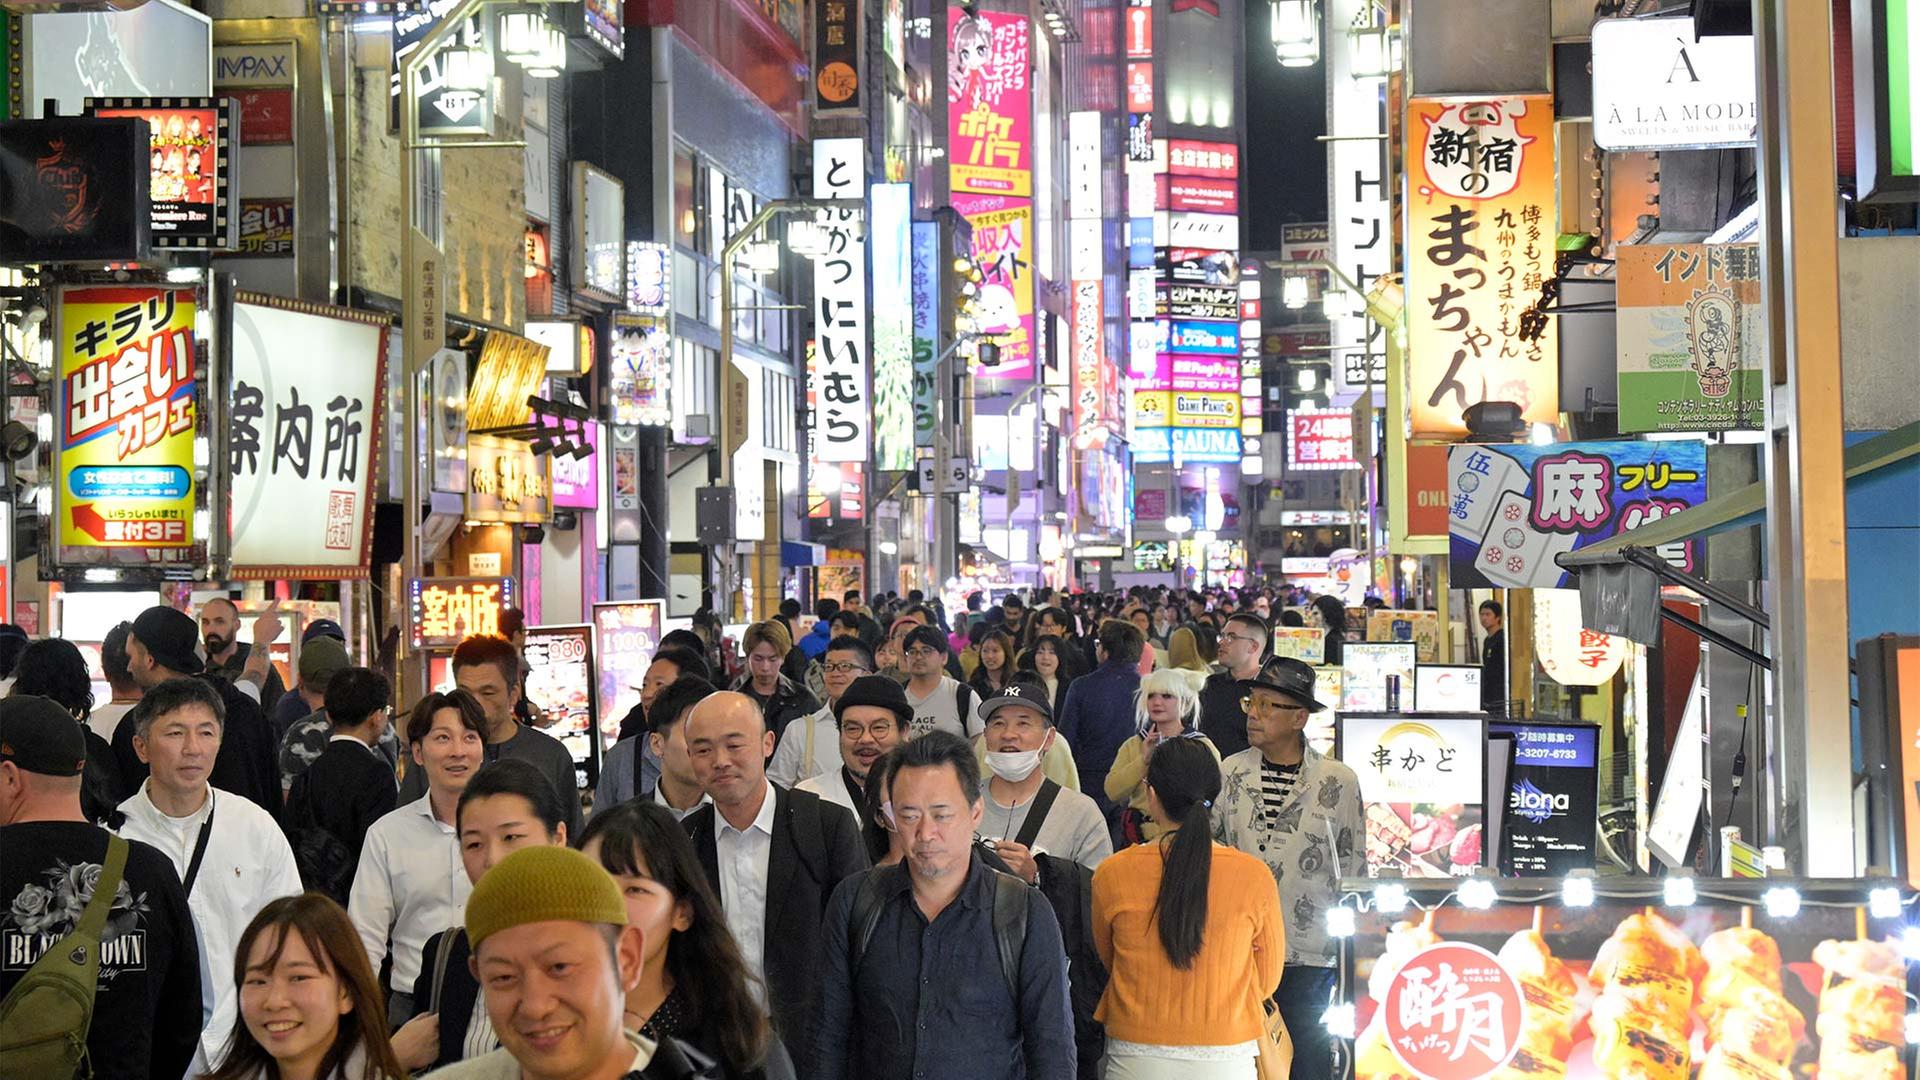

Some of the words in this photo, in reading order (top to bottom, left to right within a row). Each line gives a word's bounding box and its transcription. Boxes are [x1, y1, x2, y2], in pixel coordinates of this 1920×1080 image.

[217, 55, 286, 78] IMPAX
[991, 27, 1004, 105] ガールズバー
[1003, 24, 1015, 88] コンカフェ
[1015, 19, 1026, 90] キャバクラ
[1666, 37, 1700, 83] À
[958, 102, 1014, 137] ポケ
[1609, 103, 1622, 123] À
[1637, 106, 1667, 123] LA
[969, 136, 1021, 167] パラ
[1429, 126, 1518, 173] 新宿
[1461, 172, 1490, 195] の
[189, 210, 207, 222] Rue
[976, 209, 1028, 231] 今すぐ見つかる
[822, 157, 862, 443] とんかつにいむら
[1495, 207, 1519, 358] 九州のうまかもん
[74, 291, 175, 357] キラリ
[1427, 204, 1492, 416] まっちゃん
[69, 330, 190, 437] 出会い
[118, 393, 193, 461] カフェ
[232, 381, 363, 482] 案内所
[1172, 429, 1240, 453] SAUNA
[926, 467, 966, 482] ちら
[1617, 465, 1697, 491] フリー
[421, 584, 500, 637] 案内所
[1370, 745, 1457, 773] 串かど
[1515, 731, 1575, 744] フ臨時募集中
[1399, 962, 1507, 1063] 酔月
[1398, 1033, 1451, 1053] すいげつ
